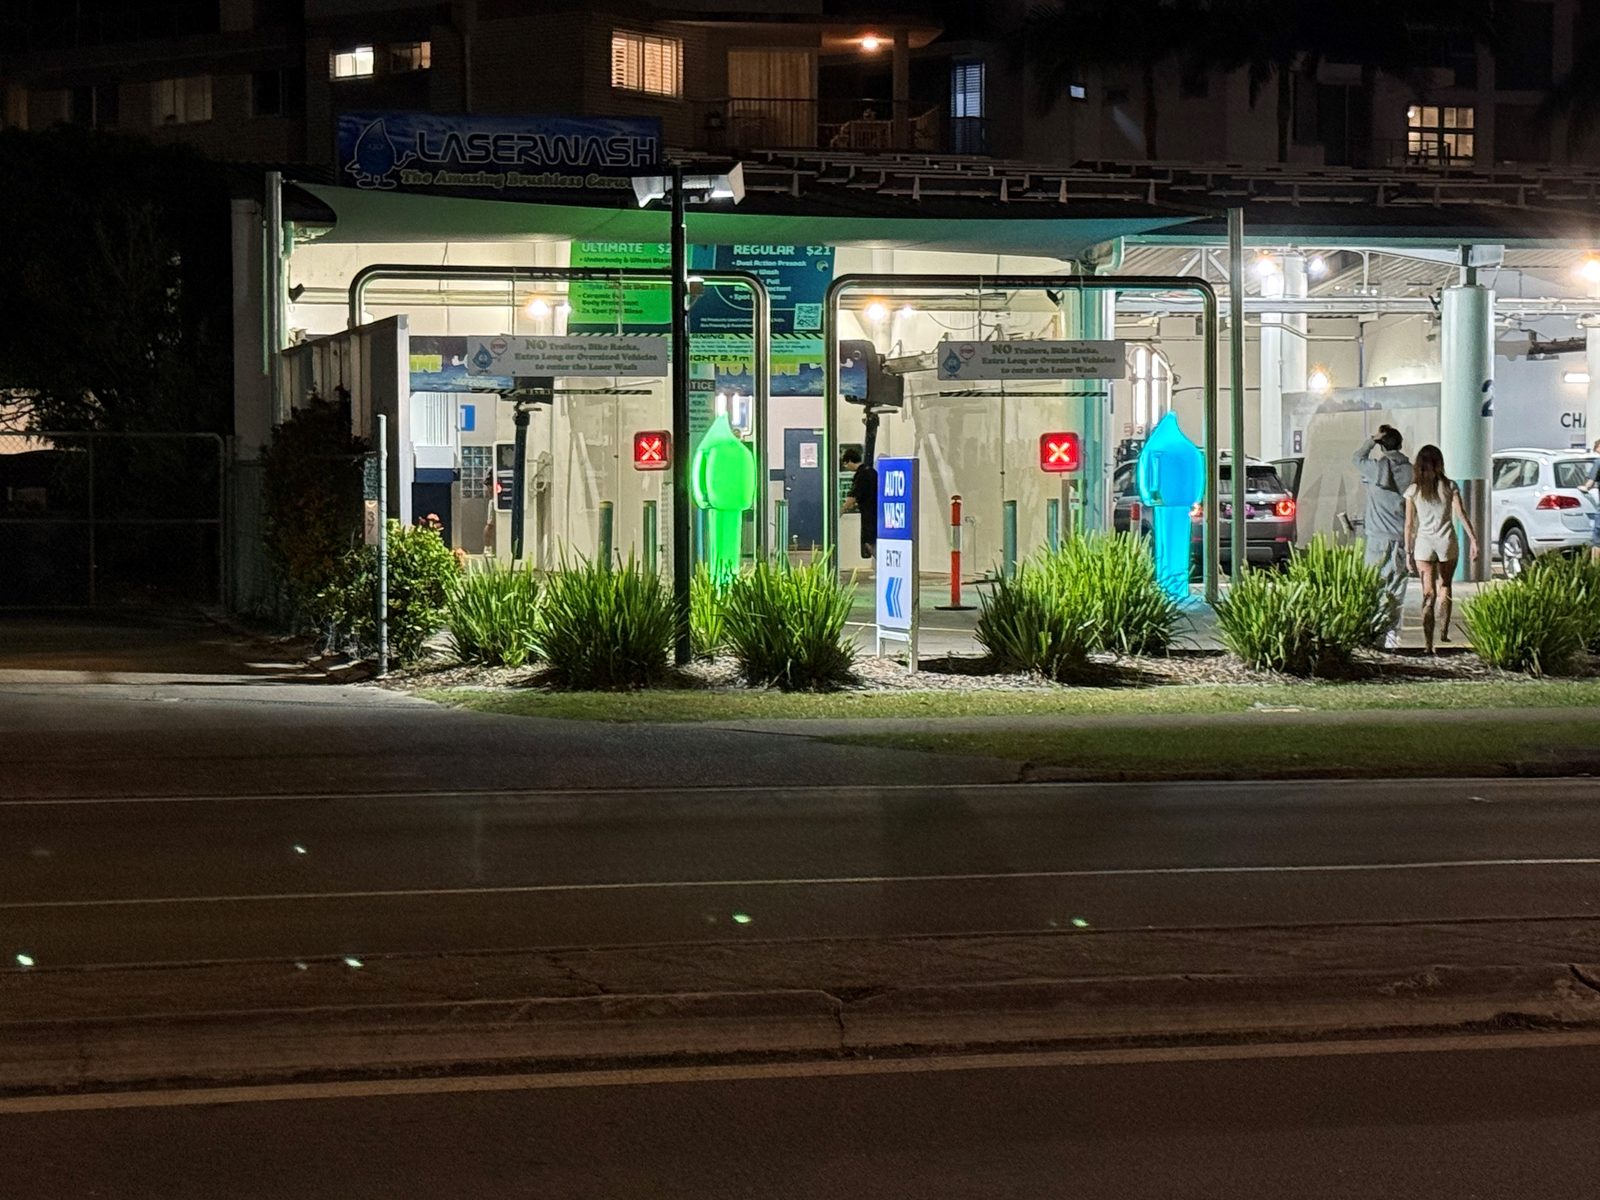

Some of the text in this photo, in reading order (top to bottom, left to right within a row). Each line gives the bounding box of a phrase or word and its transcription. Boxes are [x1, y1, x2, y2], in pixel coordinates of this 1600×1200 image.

[416, 131, 657, 167] LASERWASH
[400, 170, 634, 190] The Amazing Brushless Carw
[581, 243, 644, 253] ULTIMATE
[657, 243, 672, 254] $2
[733, 245, 795, 256] REGULAR
[806, 246, 831, 256] $21
[525, 339, 547, 350] NO
[992, 344, 1013, 354] NO
[541, 353, 564, 362] Long
[1007, 357, 1028, 366] Long
[689, 381, 714, 390] TICE
[884, 471, 905, 497] AUTO
[884, 503, 906, 528] WASH
[886, 549, 902, 567] ENTRY
